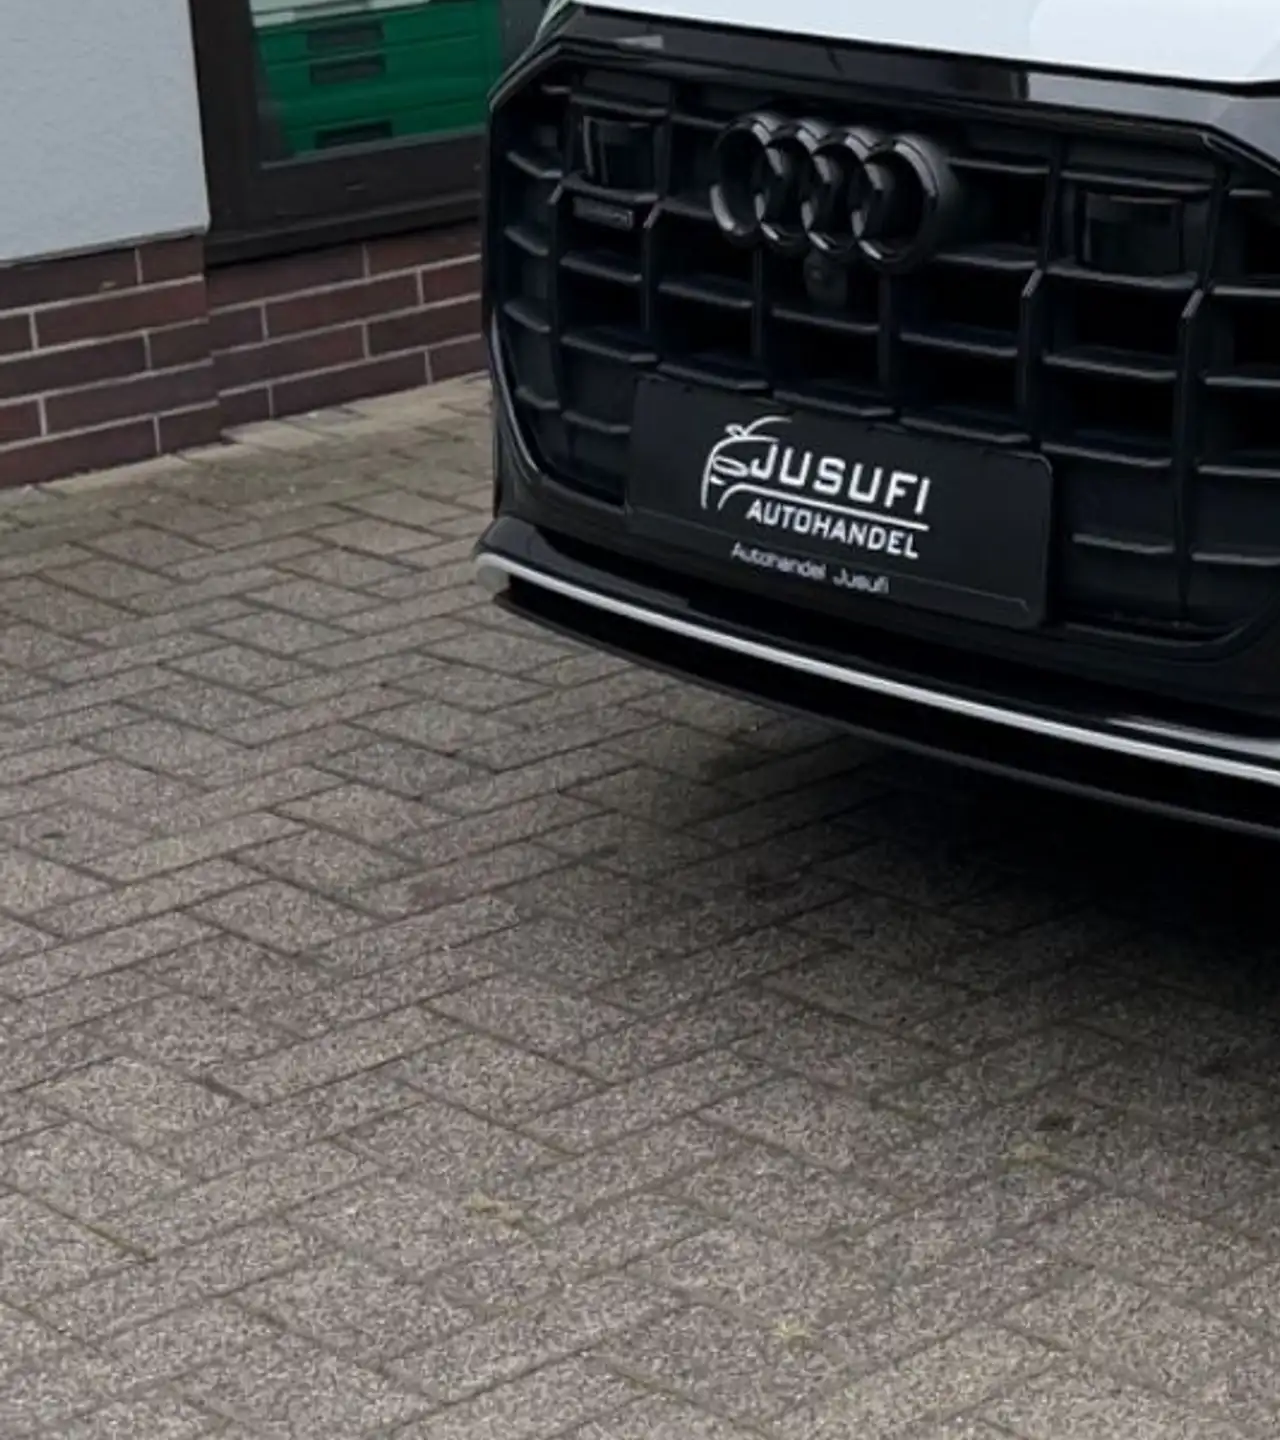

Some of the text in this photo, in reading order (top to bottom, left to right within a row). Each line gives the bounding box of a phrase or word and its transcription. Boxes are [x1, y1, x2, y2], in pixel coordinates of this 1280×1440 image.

[749, 443, 930, 515] JUSUFI
[746, 498, 919, 559] AUTOHANDEL
[730, 541, 890, 594] Autohandel Jusufi
